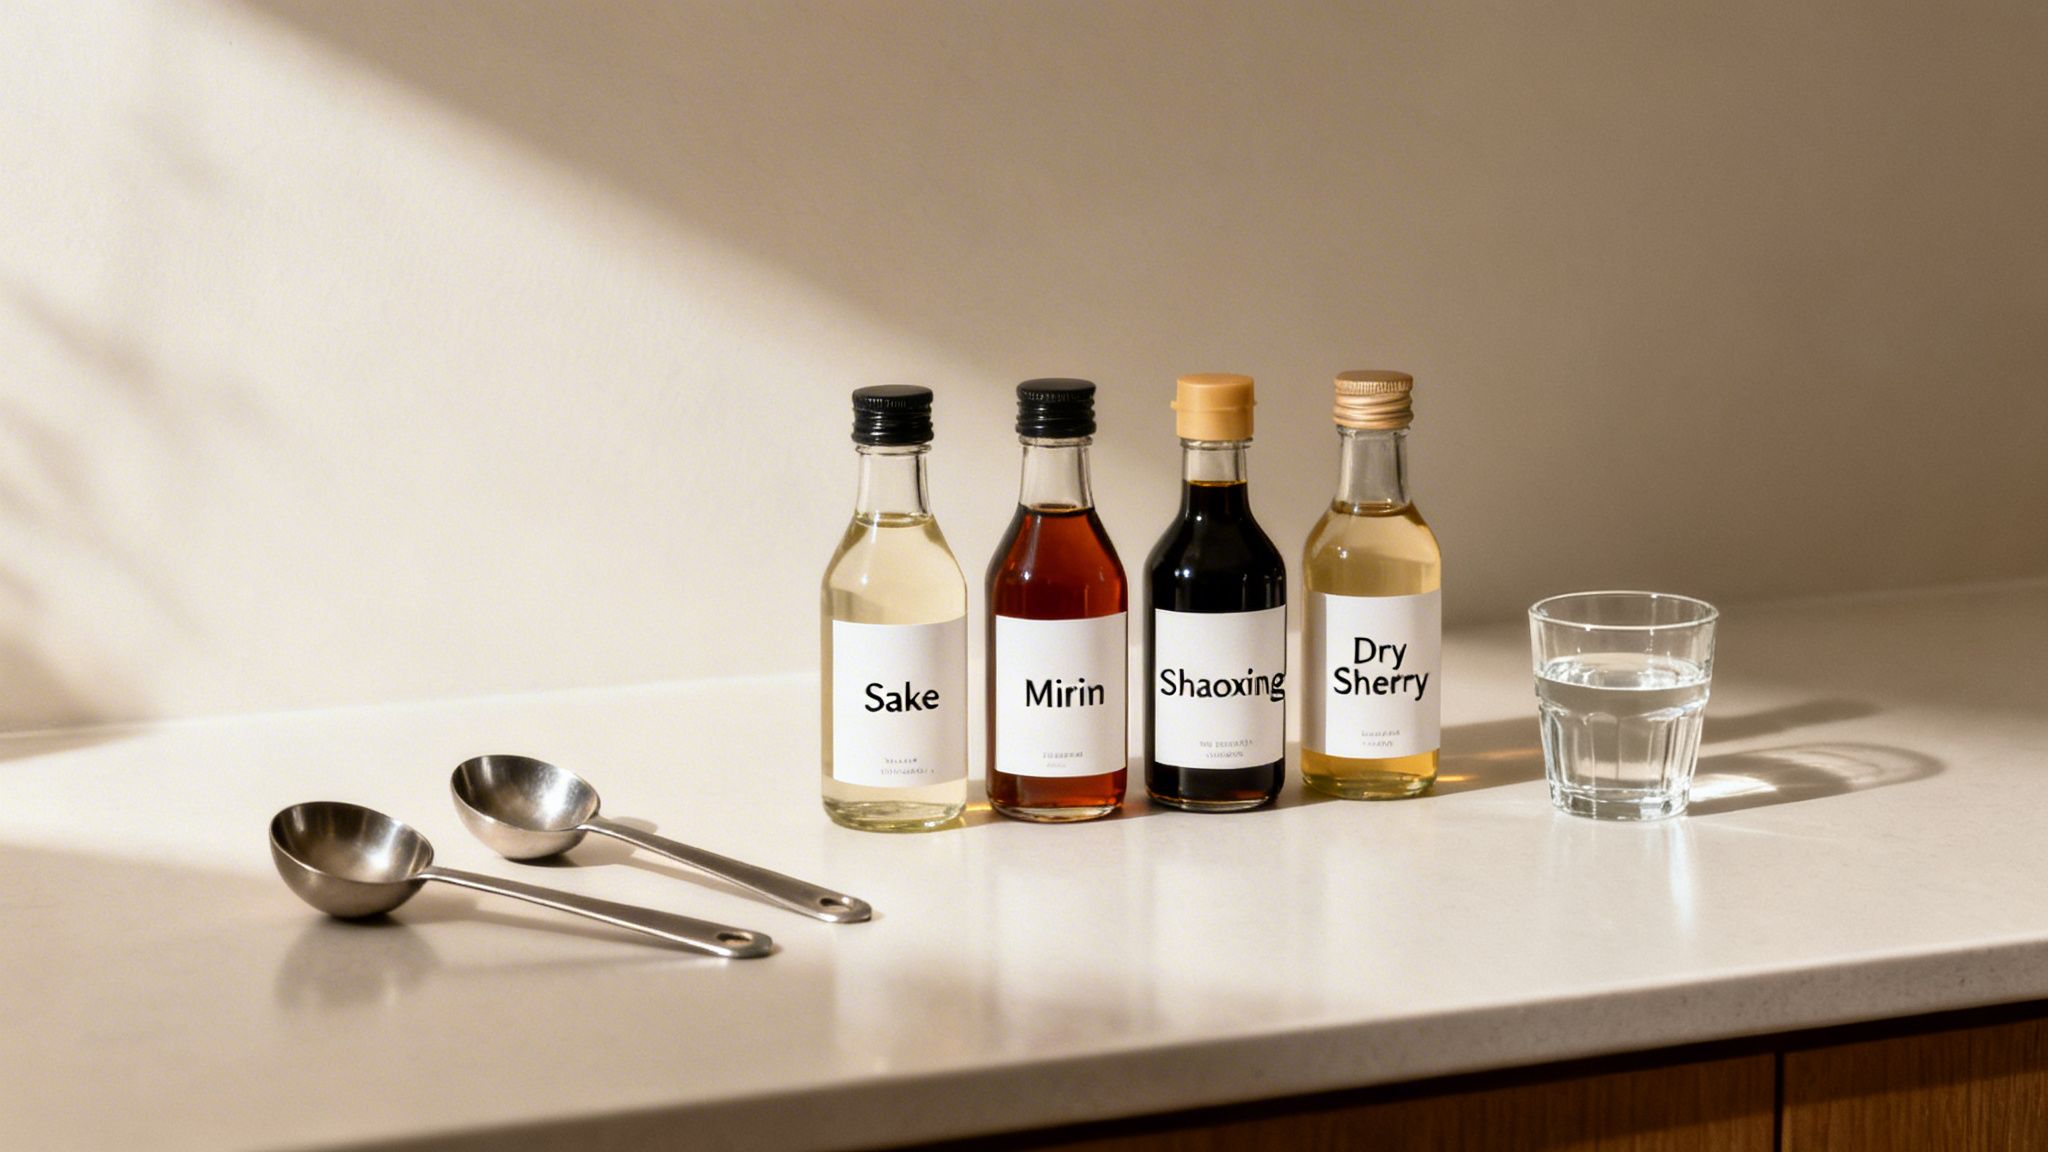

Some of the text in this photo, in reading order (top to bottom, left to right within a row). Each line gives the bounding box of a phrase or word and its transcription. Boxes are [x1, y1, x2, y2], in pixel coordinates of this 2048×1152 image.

[1354, 636, 1407, 670] Dry
[864, 681, 940, 712] Sake
[1025, 677, 1105, 708] Mirin
[1160, 668, 1286, 702] Shaoxing
[1333, 666, 1429, 701] Sherry
